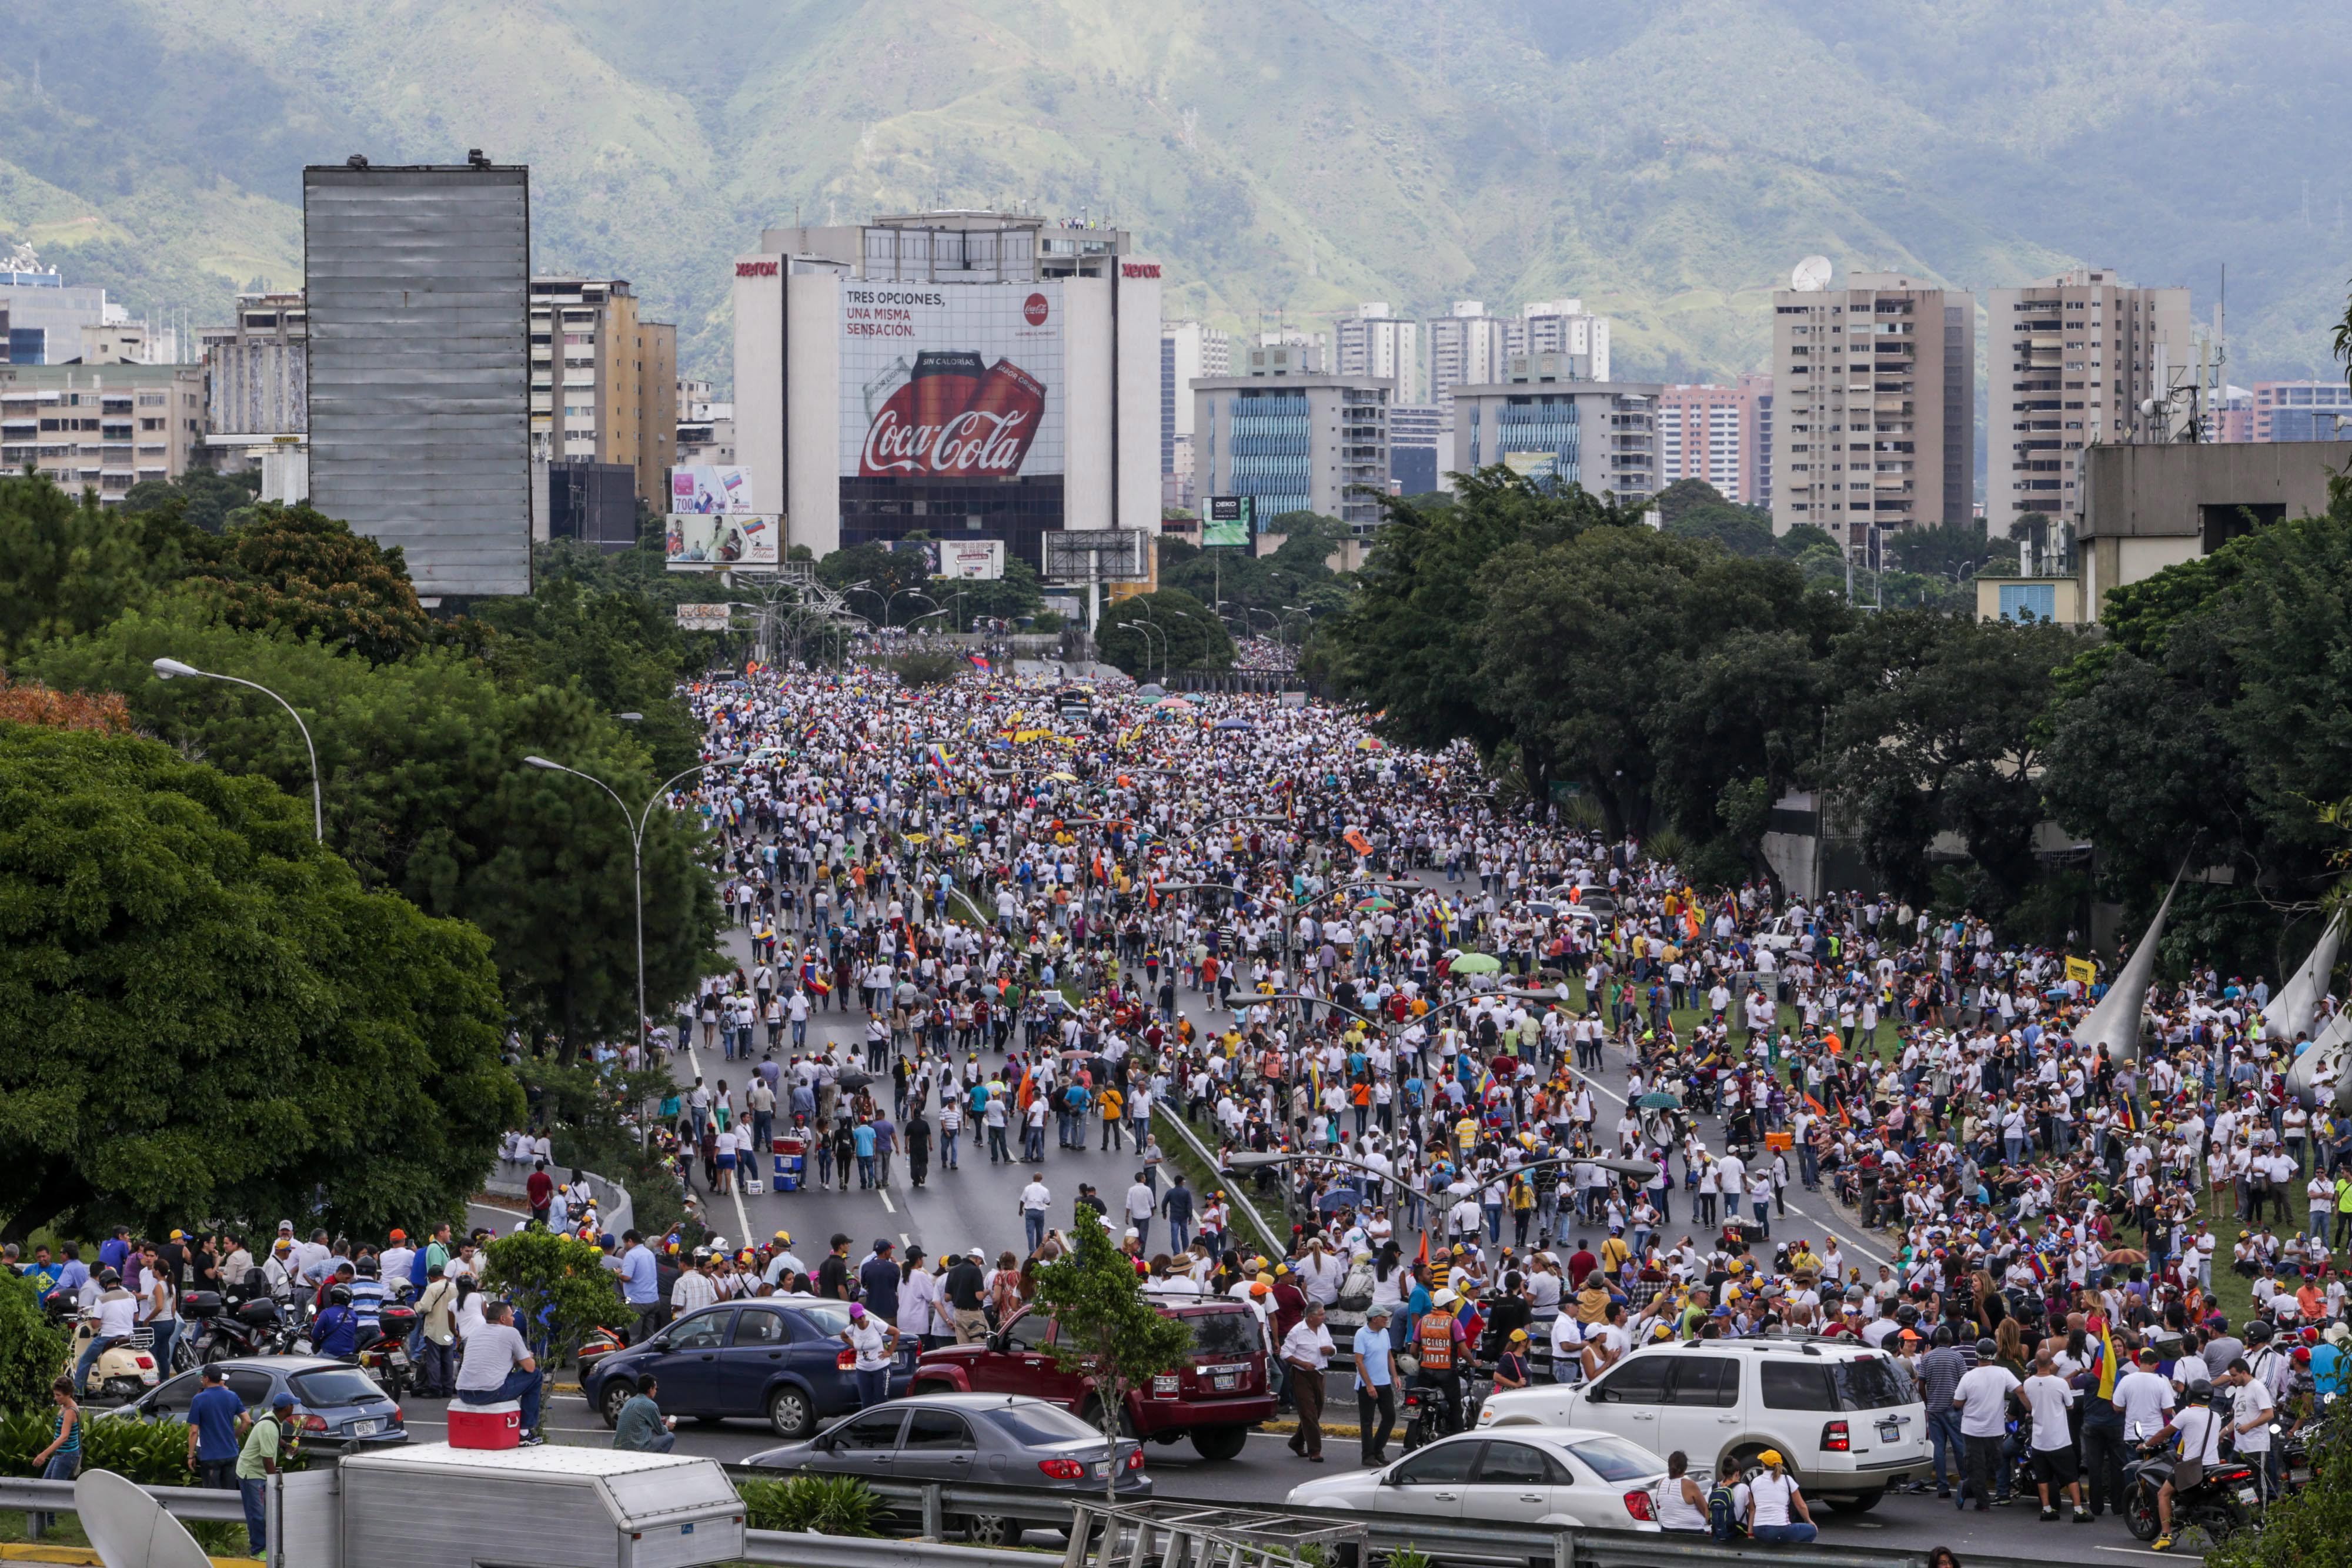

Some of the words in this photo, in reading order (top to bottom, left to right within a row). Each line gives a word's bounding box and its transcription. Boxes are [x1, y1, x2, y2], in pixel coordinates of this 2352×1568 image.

[736, 262, 778, 276] xerox
[1122, 263, 1162, 278] xerox
[847, 291, 874, 303] TRES
[878, 292, 946, 307] OPCIONES,
[847, 307, 871, 320] UNA
[874, 308, 911, 321] MISMA
[1024, 303, 1047, 314] Coca-Cola
[847, 322, 916, 337] SENSACIÓN.
[923, 357, 934, 366] SIN
[936, 357, 975, 366] CALORÍAS
[997, 365, 1018, 380] SABOR
[865, 410, 1029, 472] Coca-Cola
[1510, 458, 1553, 467] Seguimos
[676, 498, 693, 510] 700
[1422, 1338, 1450, 1348] MC14614
